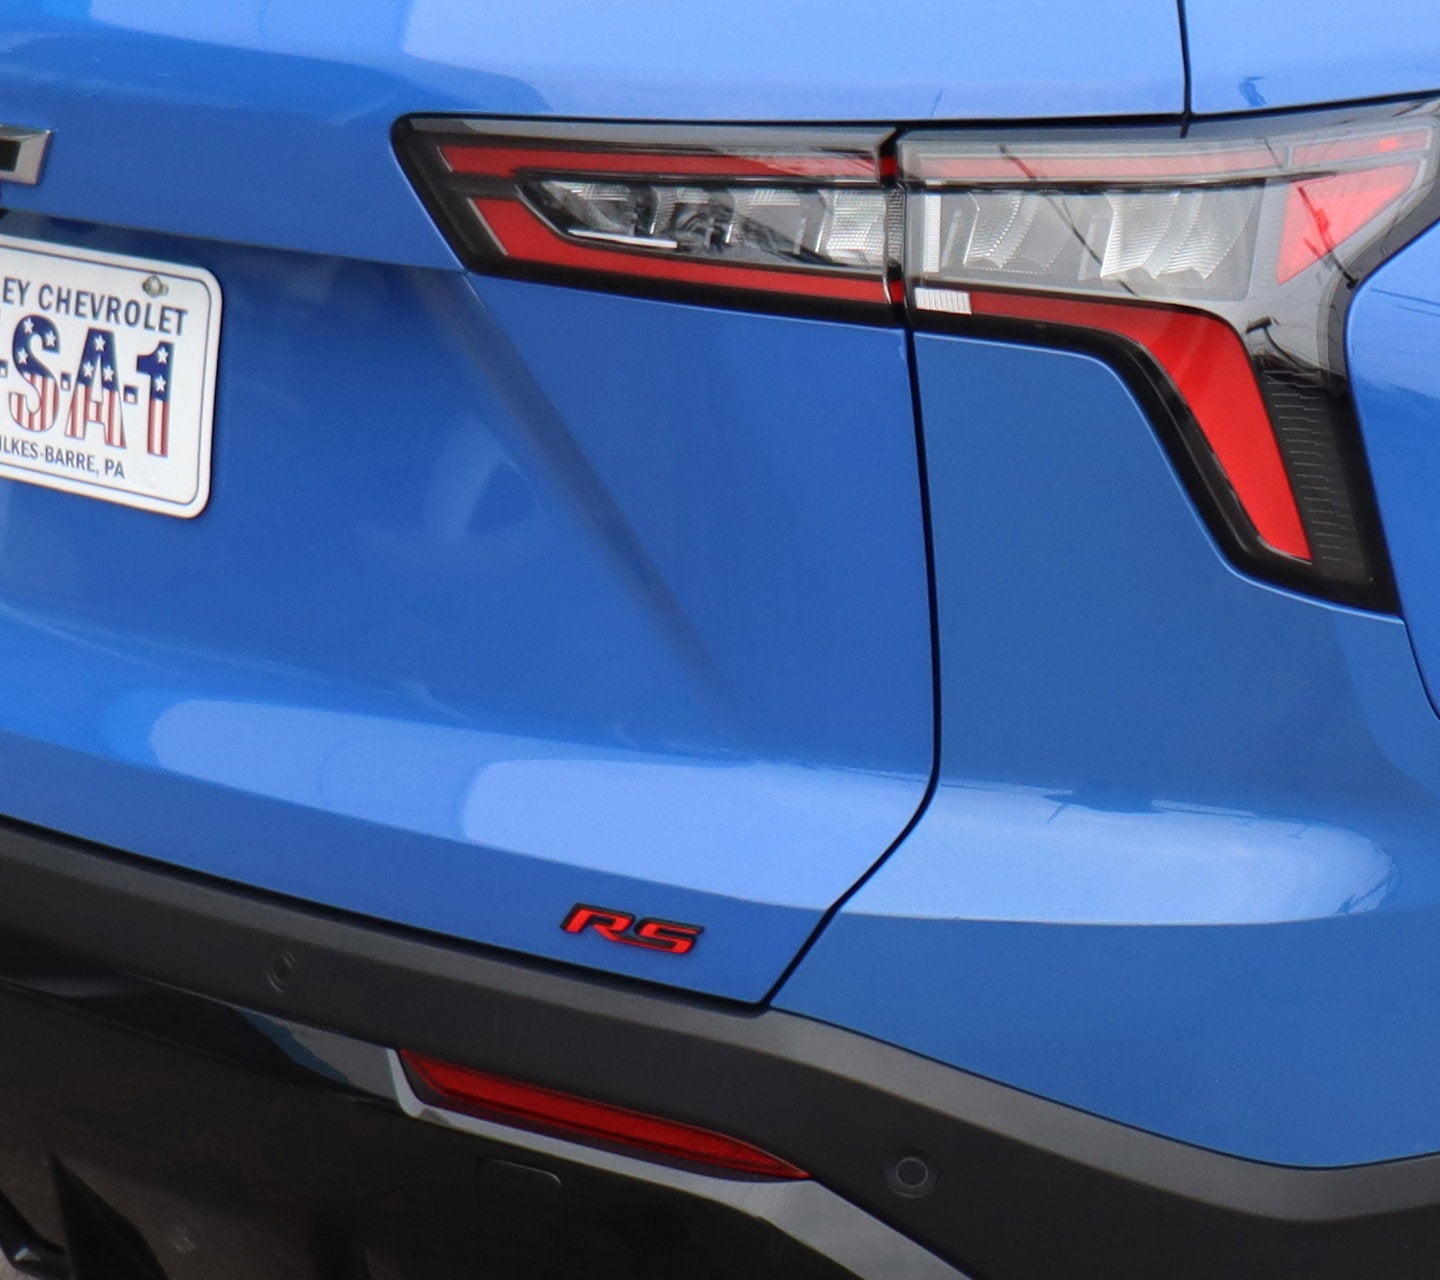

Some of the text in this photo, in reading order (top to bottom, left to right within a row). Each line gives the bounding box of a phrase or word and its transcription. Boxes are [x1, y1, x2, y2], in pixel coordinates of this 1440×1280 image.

[38, 283, 189, 337] CHEVROLET
[104, 458, 126, 479] PA
[559, 902, 705, 954] RS
